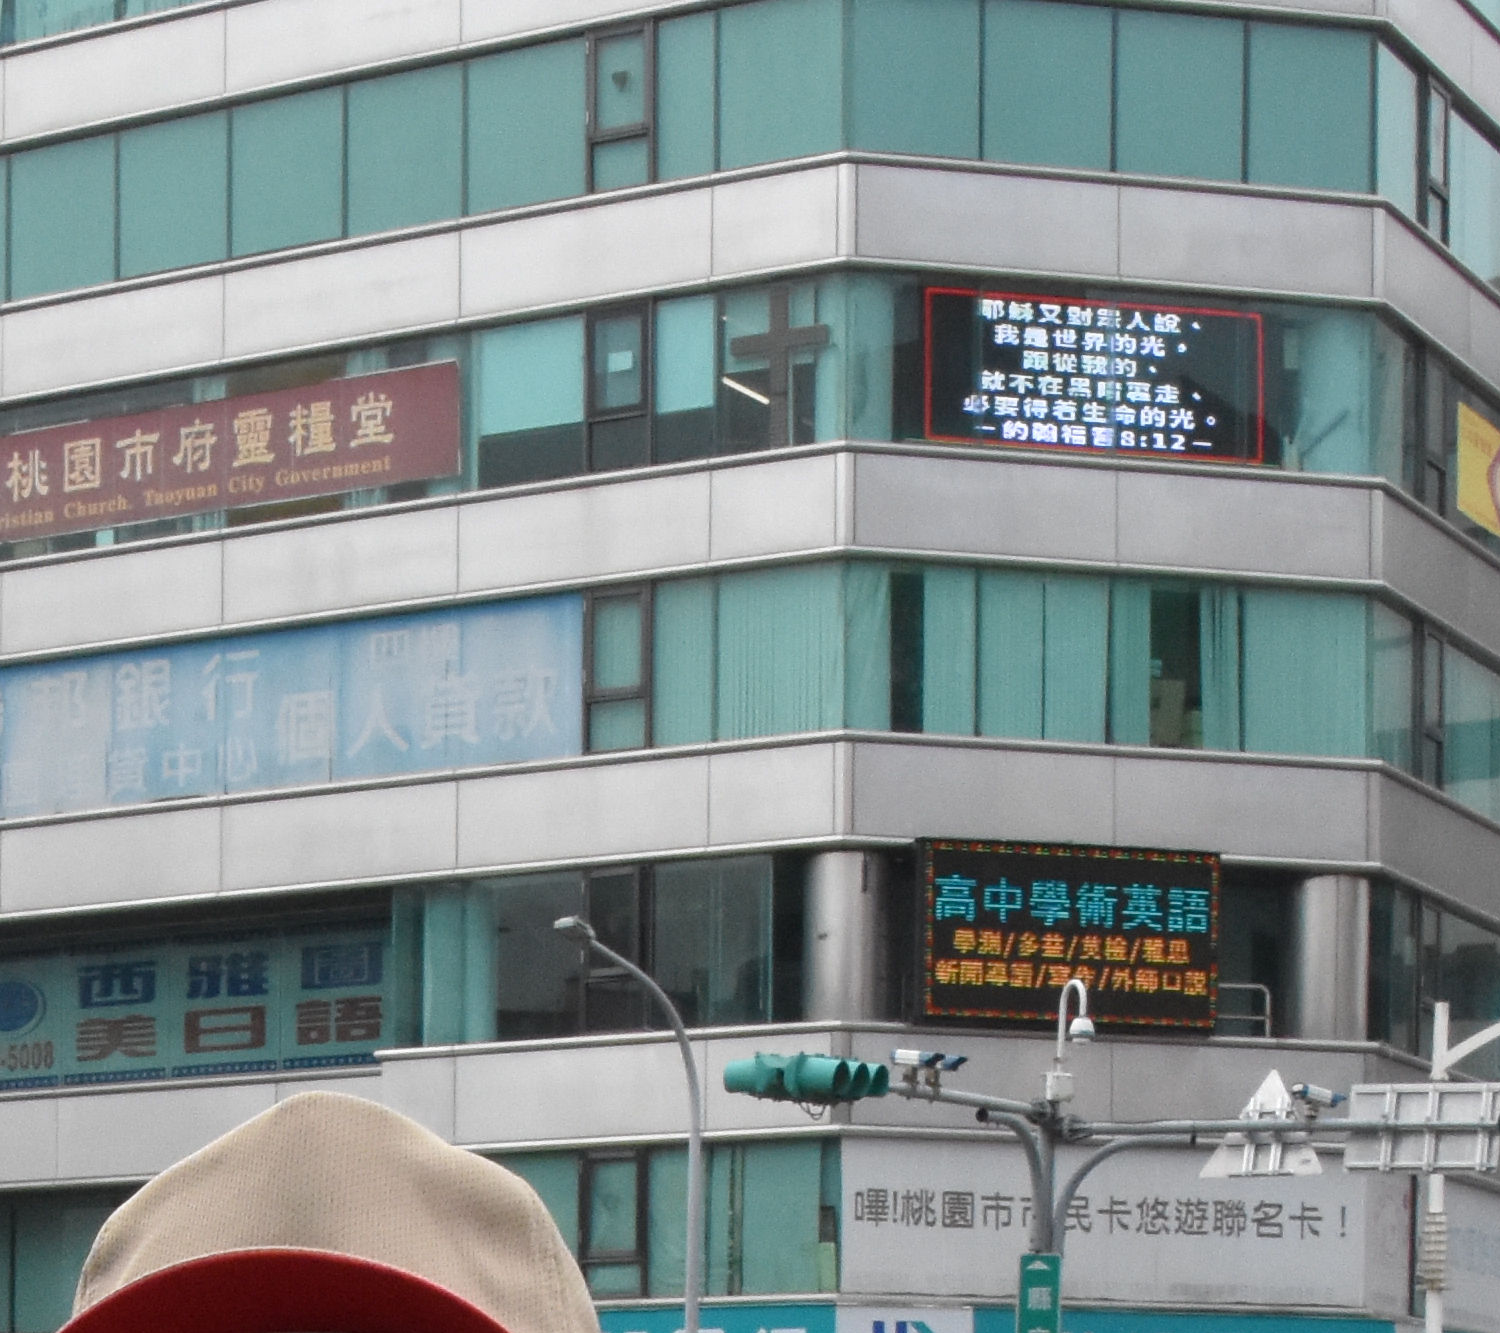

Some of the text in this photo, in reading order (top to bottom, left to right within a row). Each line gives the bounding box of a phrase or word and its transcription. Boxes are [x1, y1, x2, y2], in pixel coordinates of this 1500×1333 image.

[144, 482, 218, 509] Taoyuan
[229, 473, 264, 495] City
[275, 455, 391, 487] Government
[935, 874, 1210, 934] 高中學術英語
[75, 996, 384, 1062] 美日語
